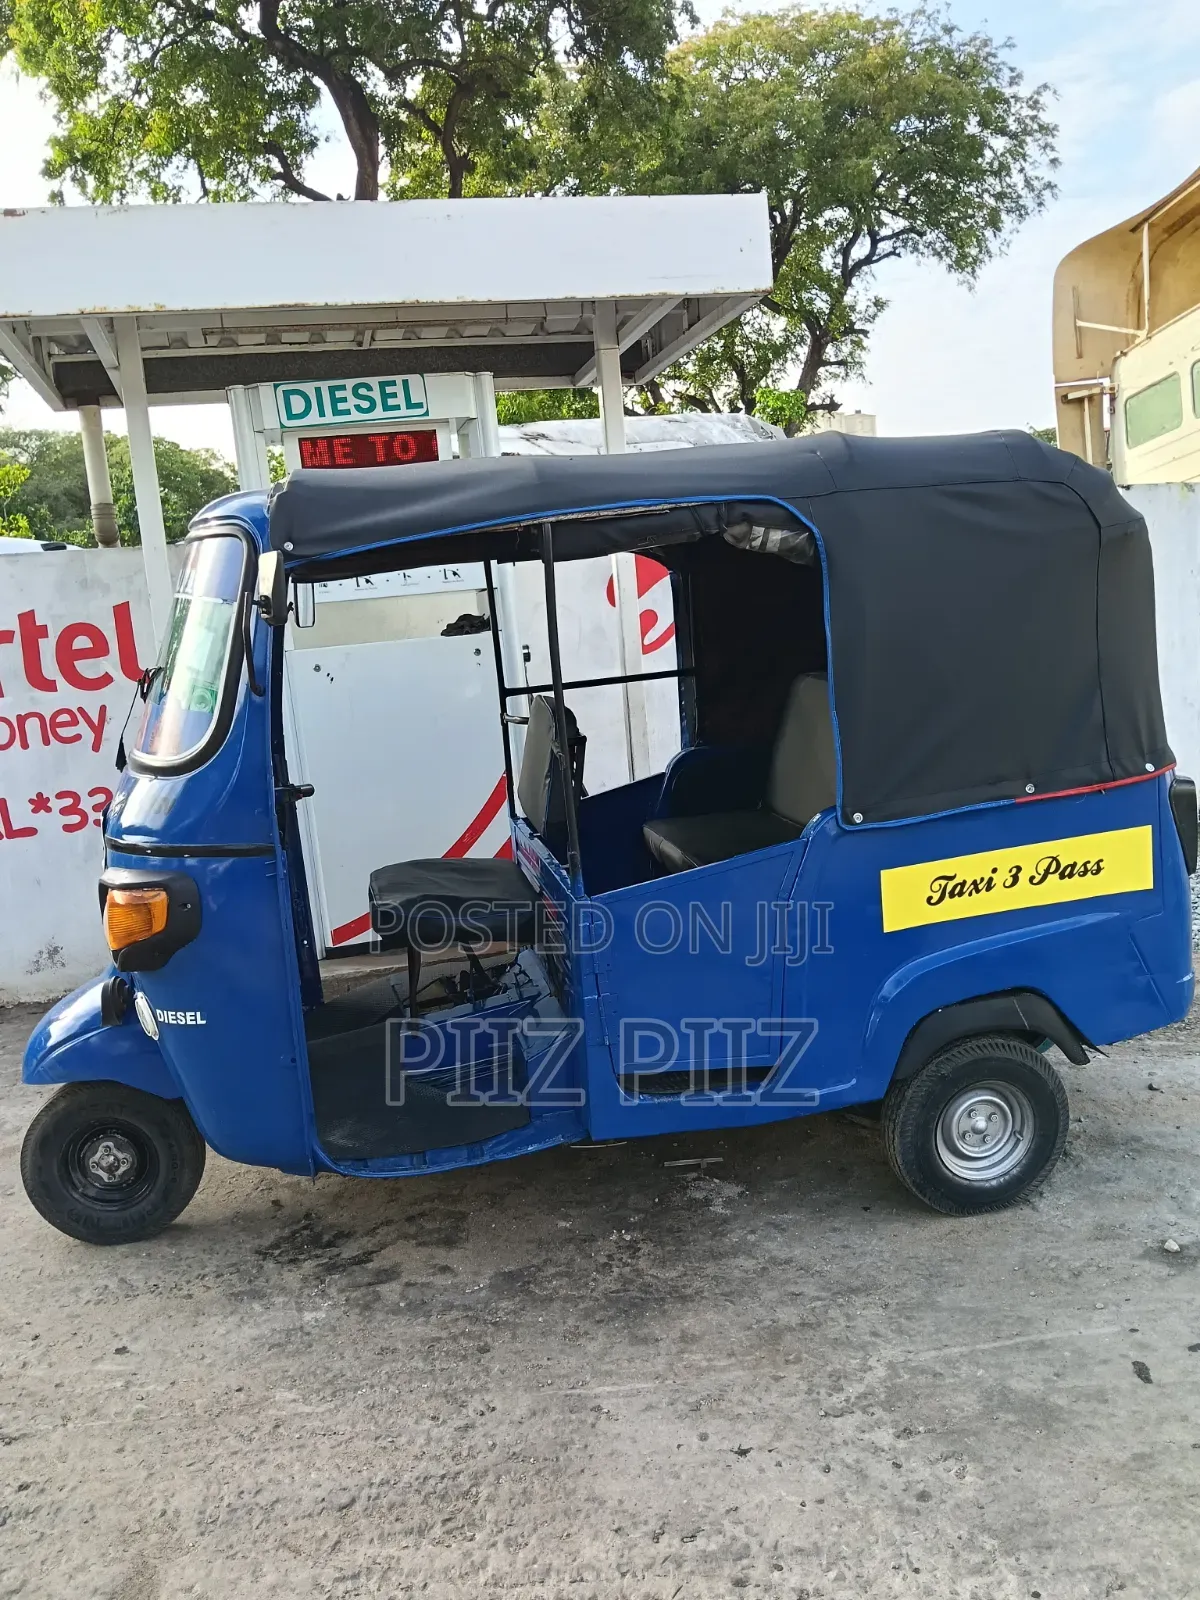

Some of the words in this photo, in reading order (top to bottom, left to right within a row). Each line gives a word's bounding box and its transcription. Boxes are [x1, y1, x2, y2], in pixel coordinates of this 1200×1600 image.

[282, 378, 424, 421] DIESEL
[302, 438, 355, 467] ME
[368, 434, 417, 462] TO
[926, 867, 997, 906] Taxi
[1002, 865, 1023, 888] 3
[1029, 854, 1105, 886] Pass
[156, 1009, 206, 1025] DIESEL
